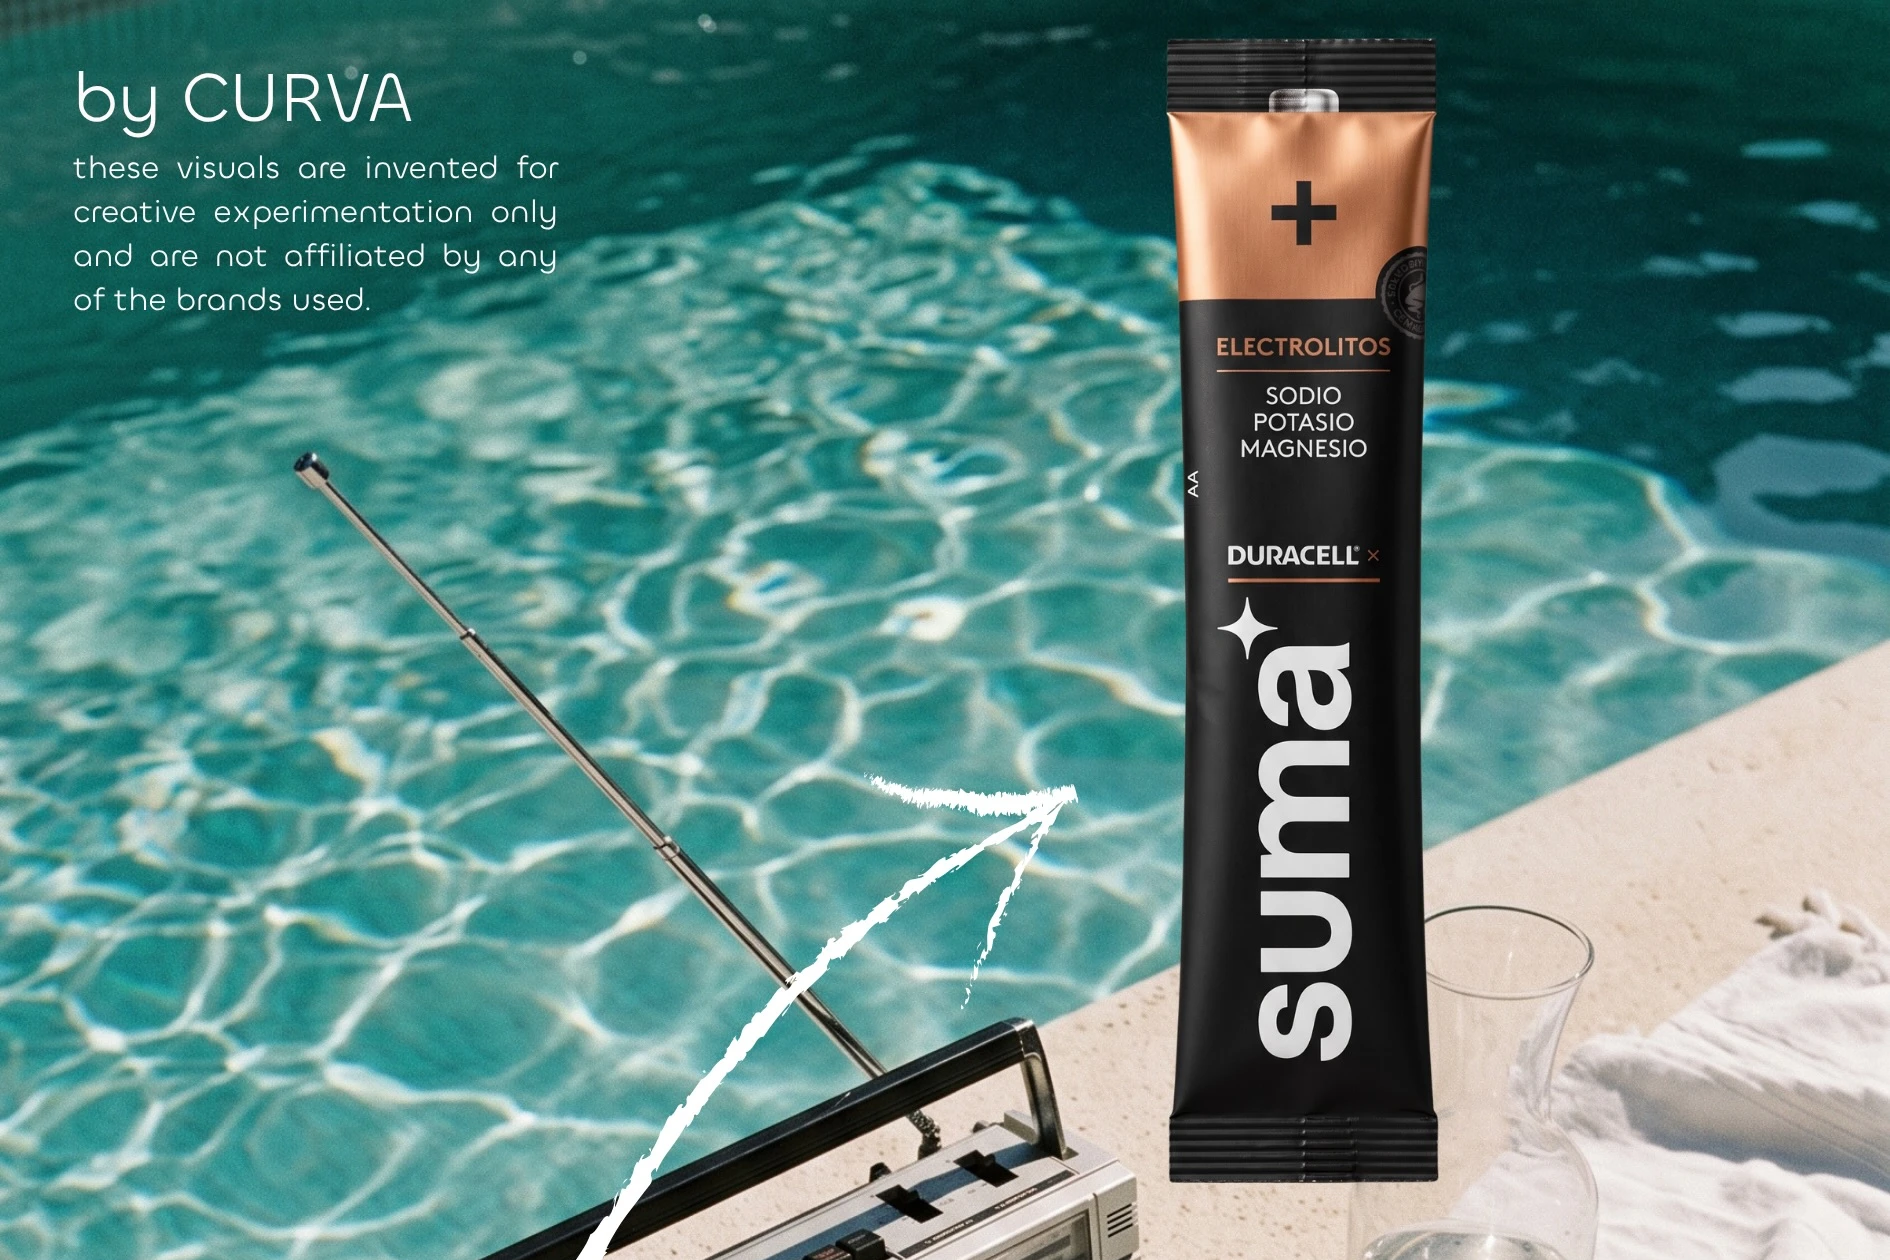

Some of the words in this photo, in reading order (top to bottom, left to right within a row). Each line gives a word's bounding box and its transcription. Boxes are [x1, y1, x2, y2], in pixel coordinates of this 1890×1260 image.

[1216, 337, 1391, 357] ELECTROLITOS
[1266, 386, 1342, 405] SODIO
[1254, 412, 1355, 432] POTASIO
[1241, 438, 1368, 458] MAGNESIO
[1187, 470, 1199, 498] AA
[1258, 641, 1353, 1062] suma
